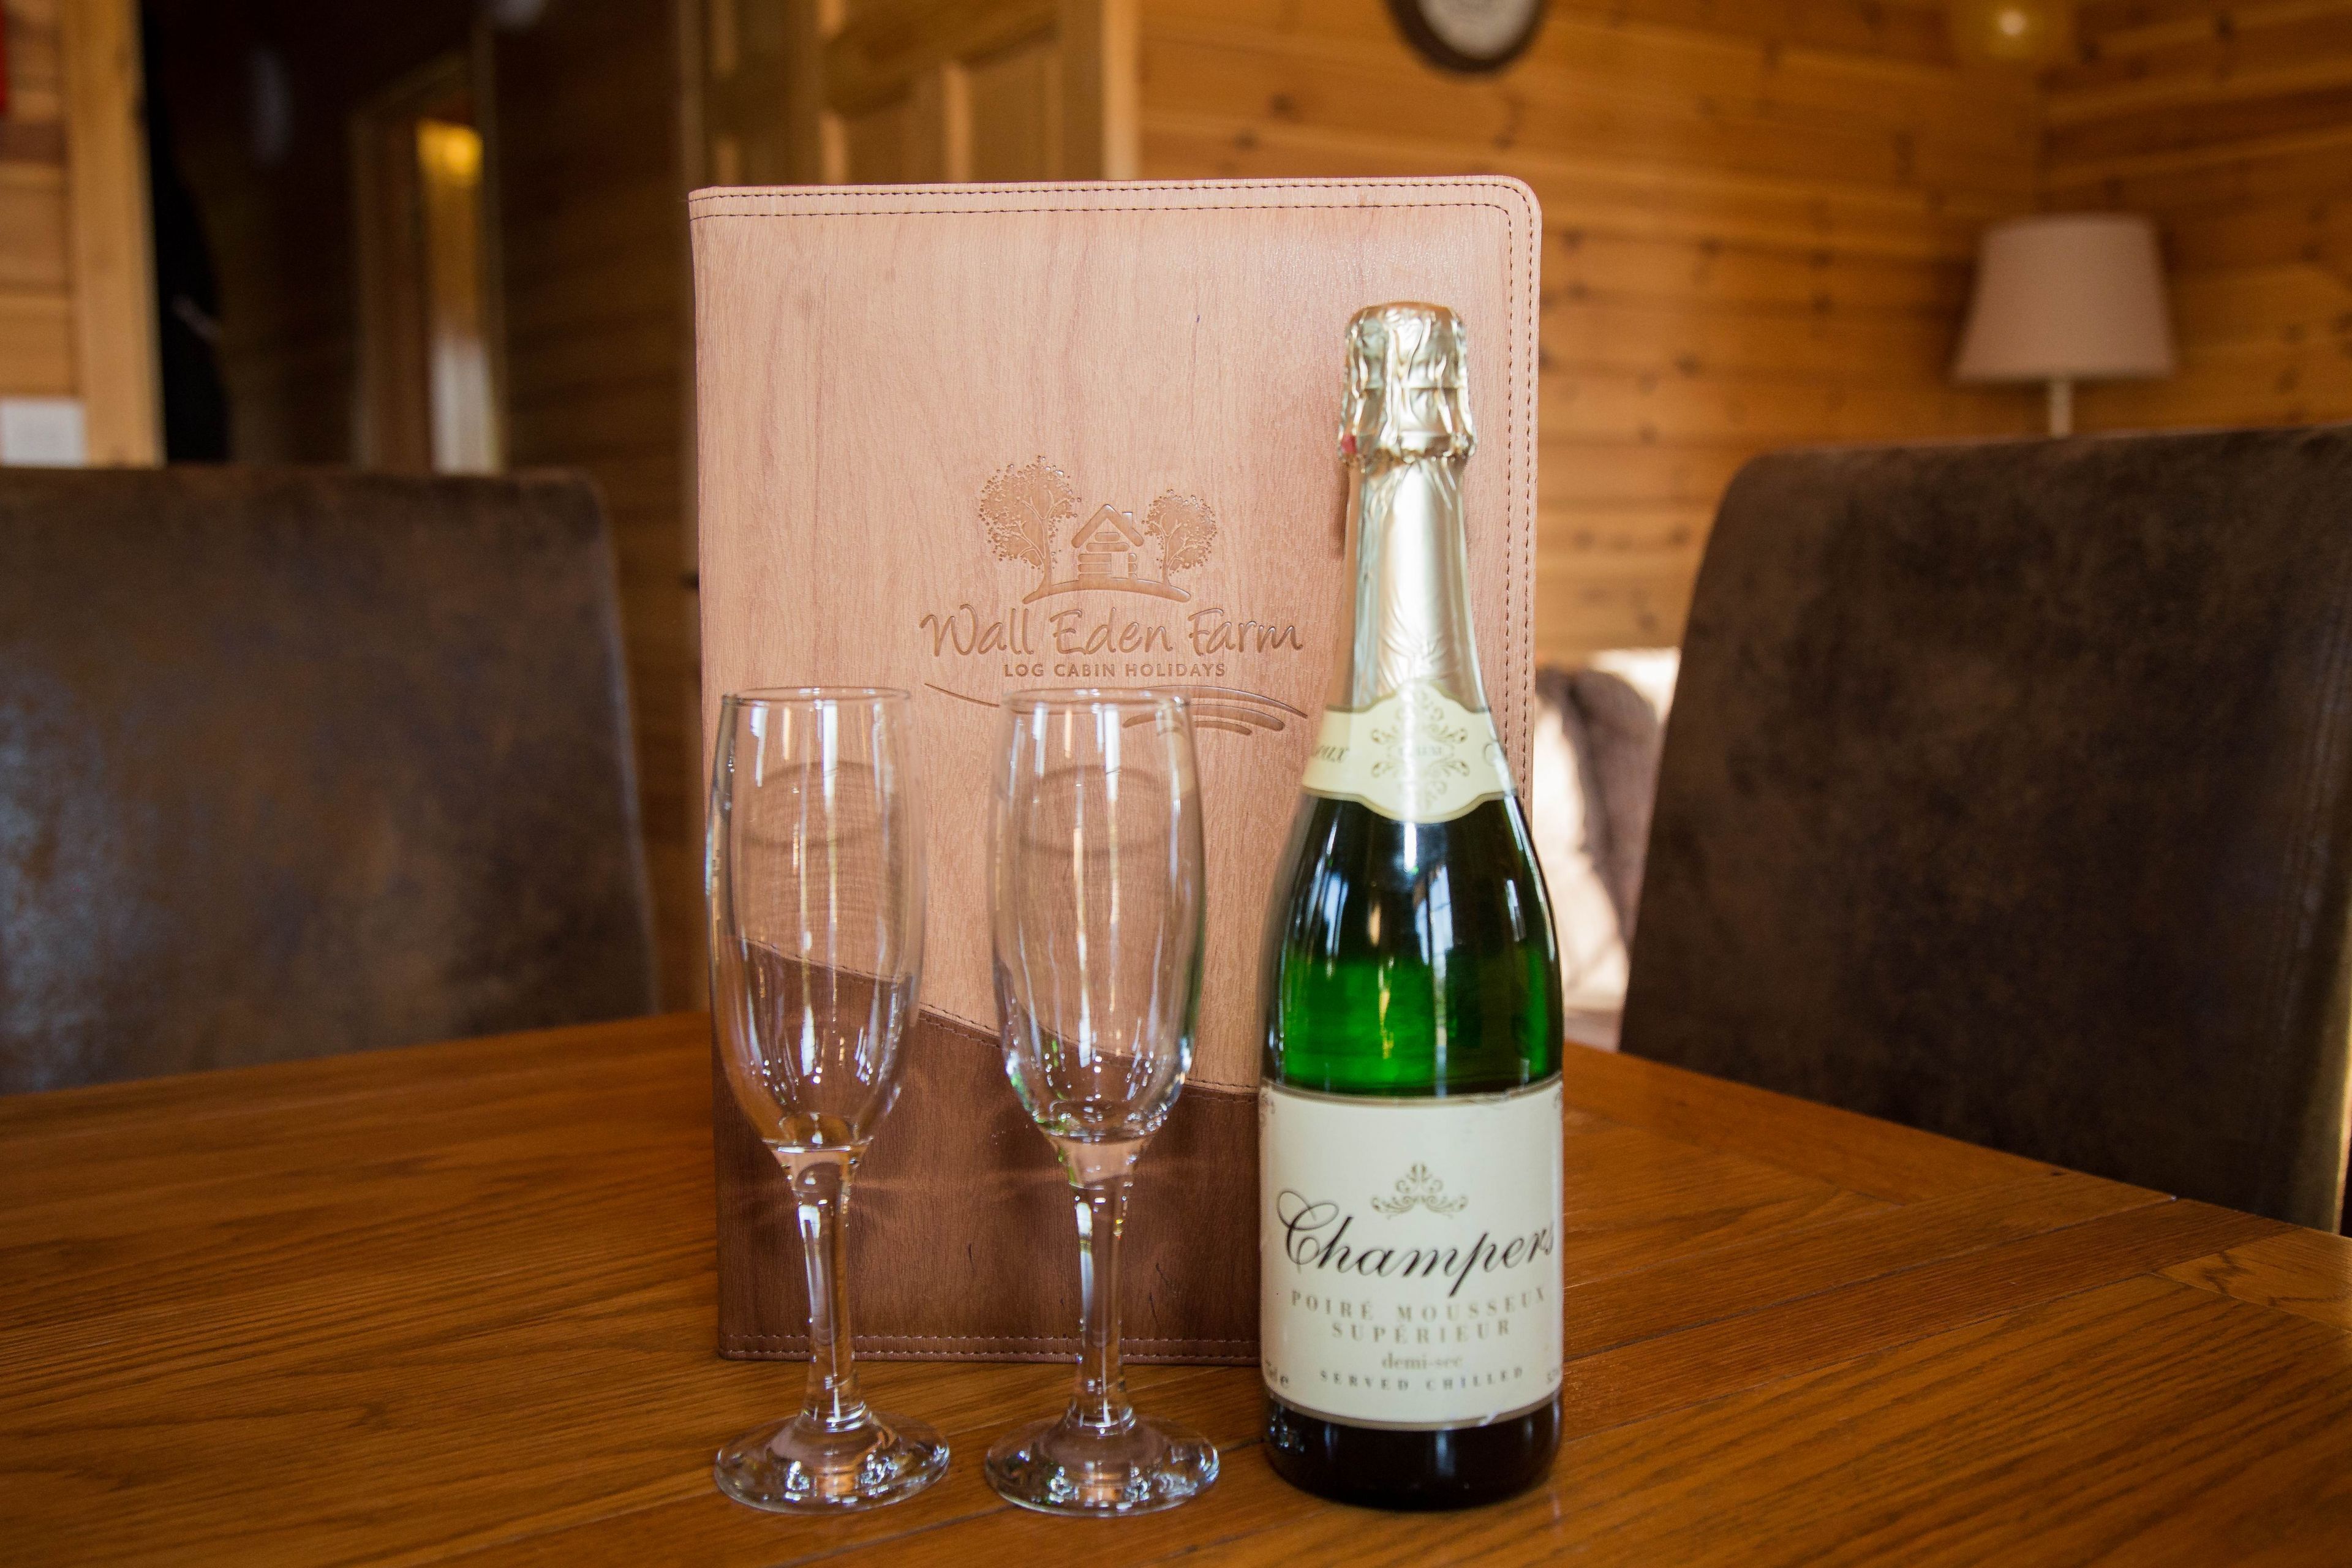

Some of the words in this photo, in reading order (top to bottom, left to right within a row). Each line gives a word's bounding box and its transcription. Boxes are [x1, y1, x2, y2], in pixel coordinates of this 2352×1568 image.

[919, 604, 1035, 657] Wall
[1050, 608, 1173, 655] Eden
[1188, 608, 1303, 656] Farm
[1004, 664, 1044, 677] LOG
[1054, 664, 1115, 677] CABIN
[1126, 663, 1225, 677] HOLIDAYS
[1276, 1191, 1555, 1298] Champers
